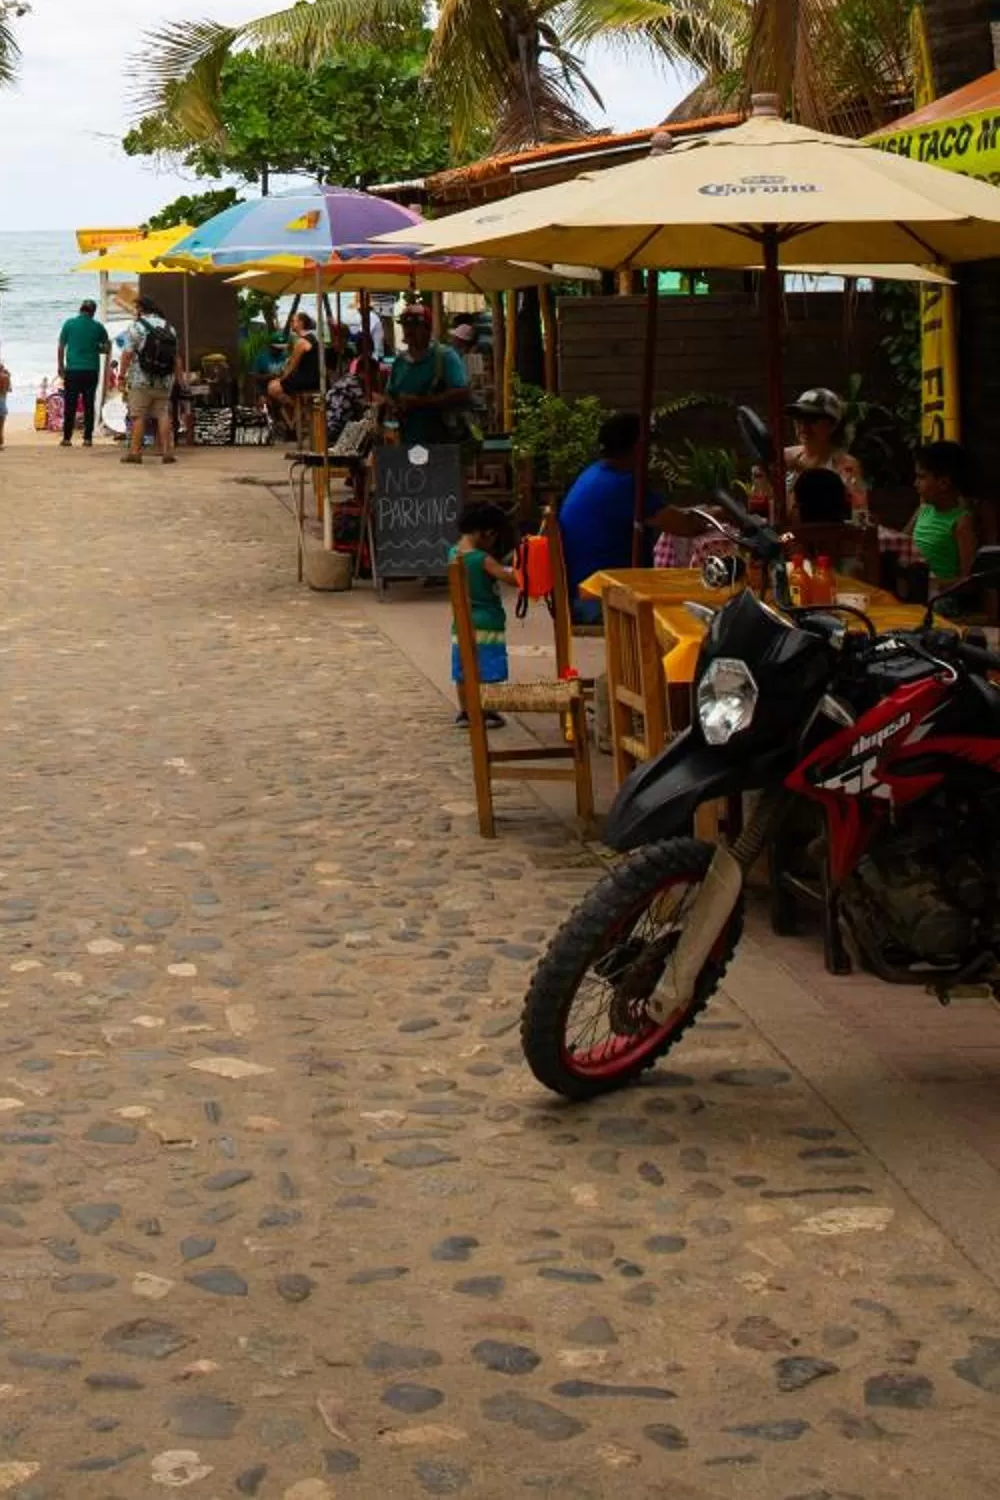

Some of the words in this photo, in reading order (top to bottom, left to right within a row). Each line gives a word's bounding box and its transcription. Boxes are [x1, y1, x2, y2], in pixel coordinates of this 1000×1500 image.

[917, 122, 973, 162] TACO
[698, 182, 821, 197] Corona
[385, 467, 426, 493] NO
[379, 494, 457, 531] PARKING
